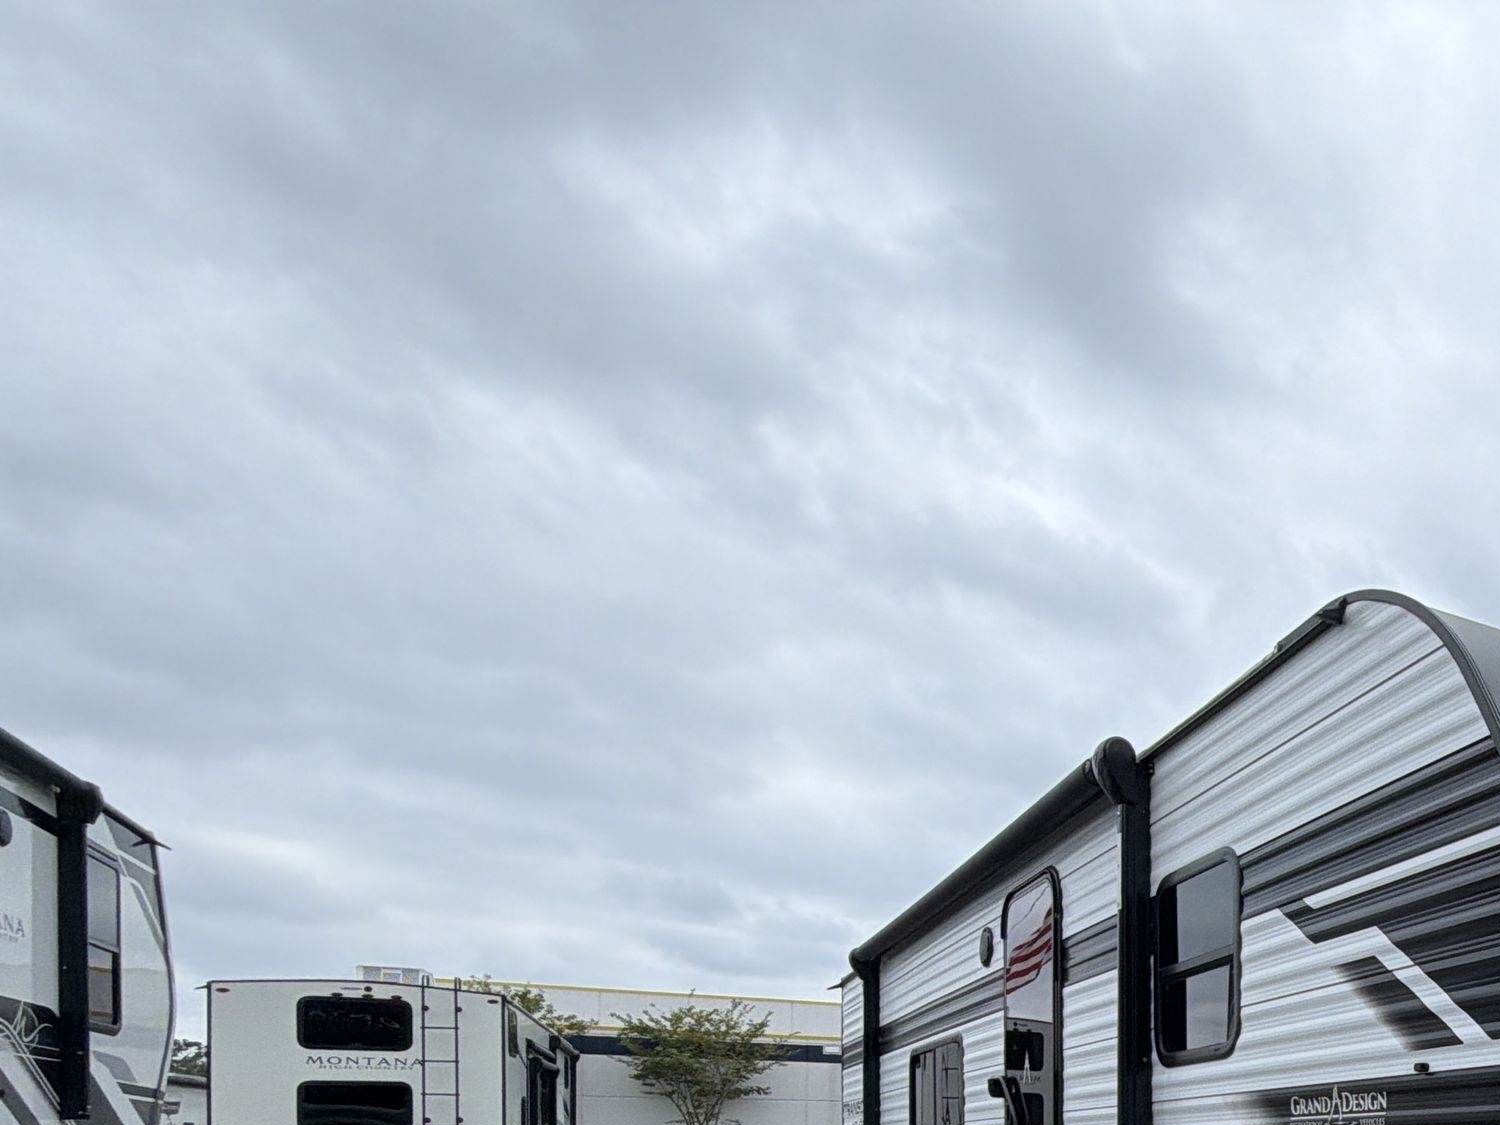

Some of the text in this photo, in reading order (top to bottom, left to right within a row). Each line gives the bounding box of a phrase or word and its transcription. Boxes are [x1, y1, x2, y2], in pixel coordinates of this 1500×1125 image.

[306, 1055, 423, 1067] MONTANA
[1290, 1091, 1387, 1115] GRAND DESIGN
[1360, 1118, 1385, 1125] VEHICLES
